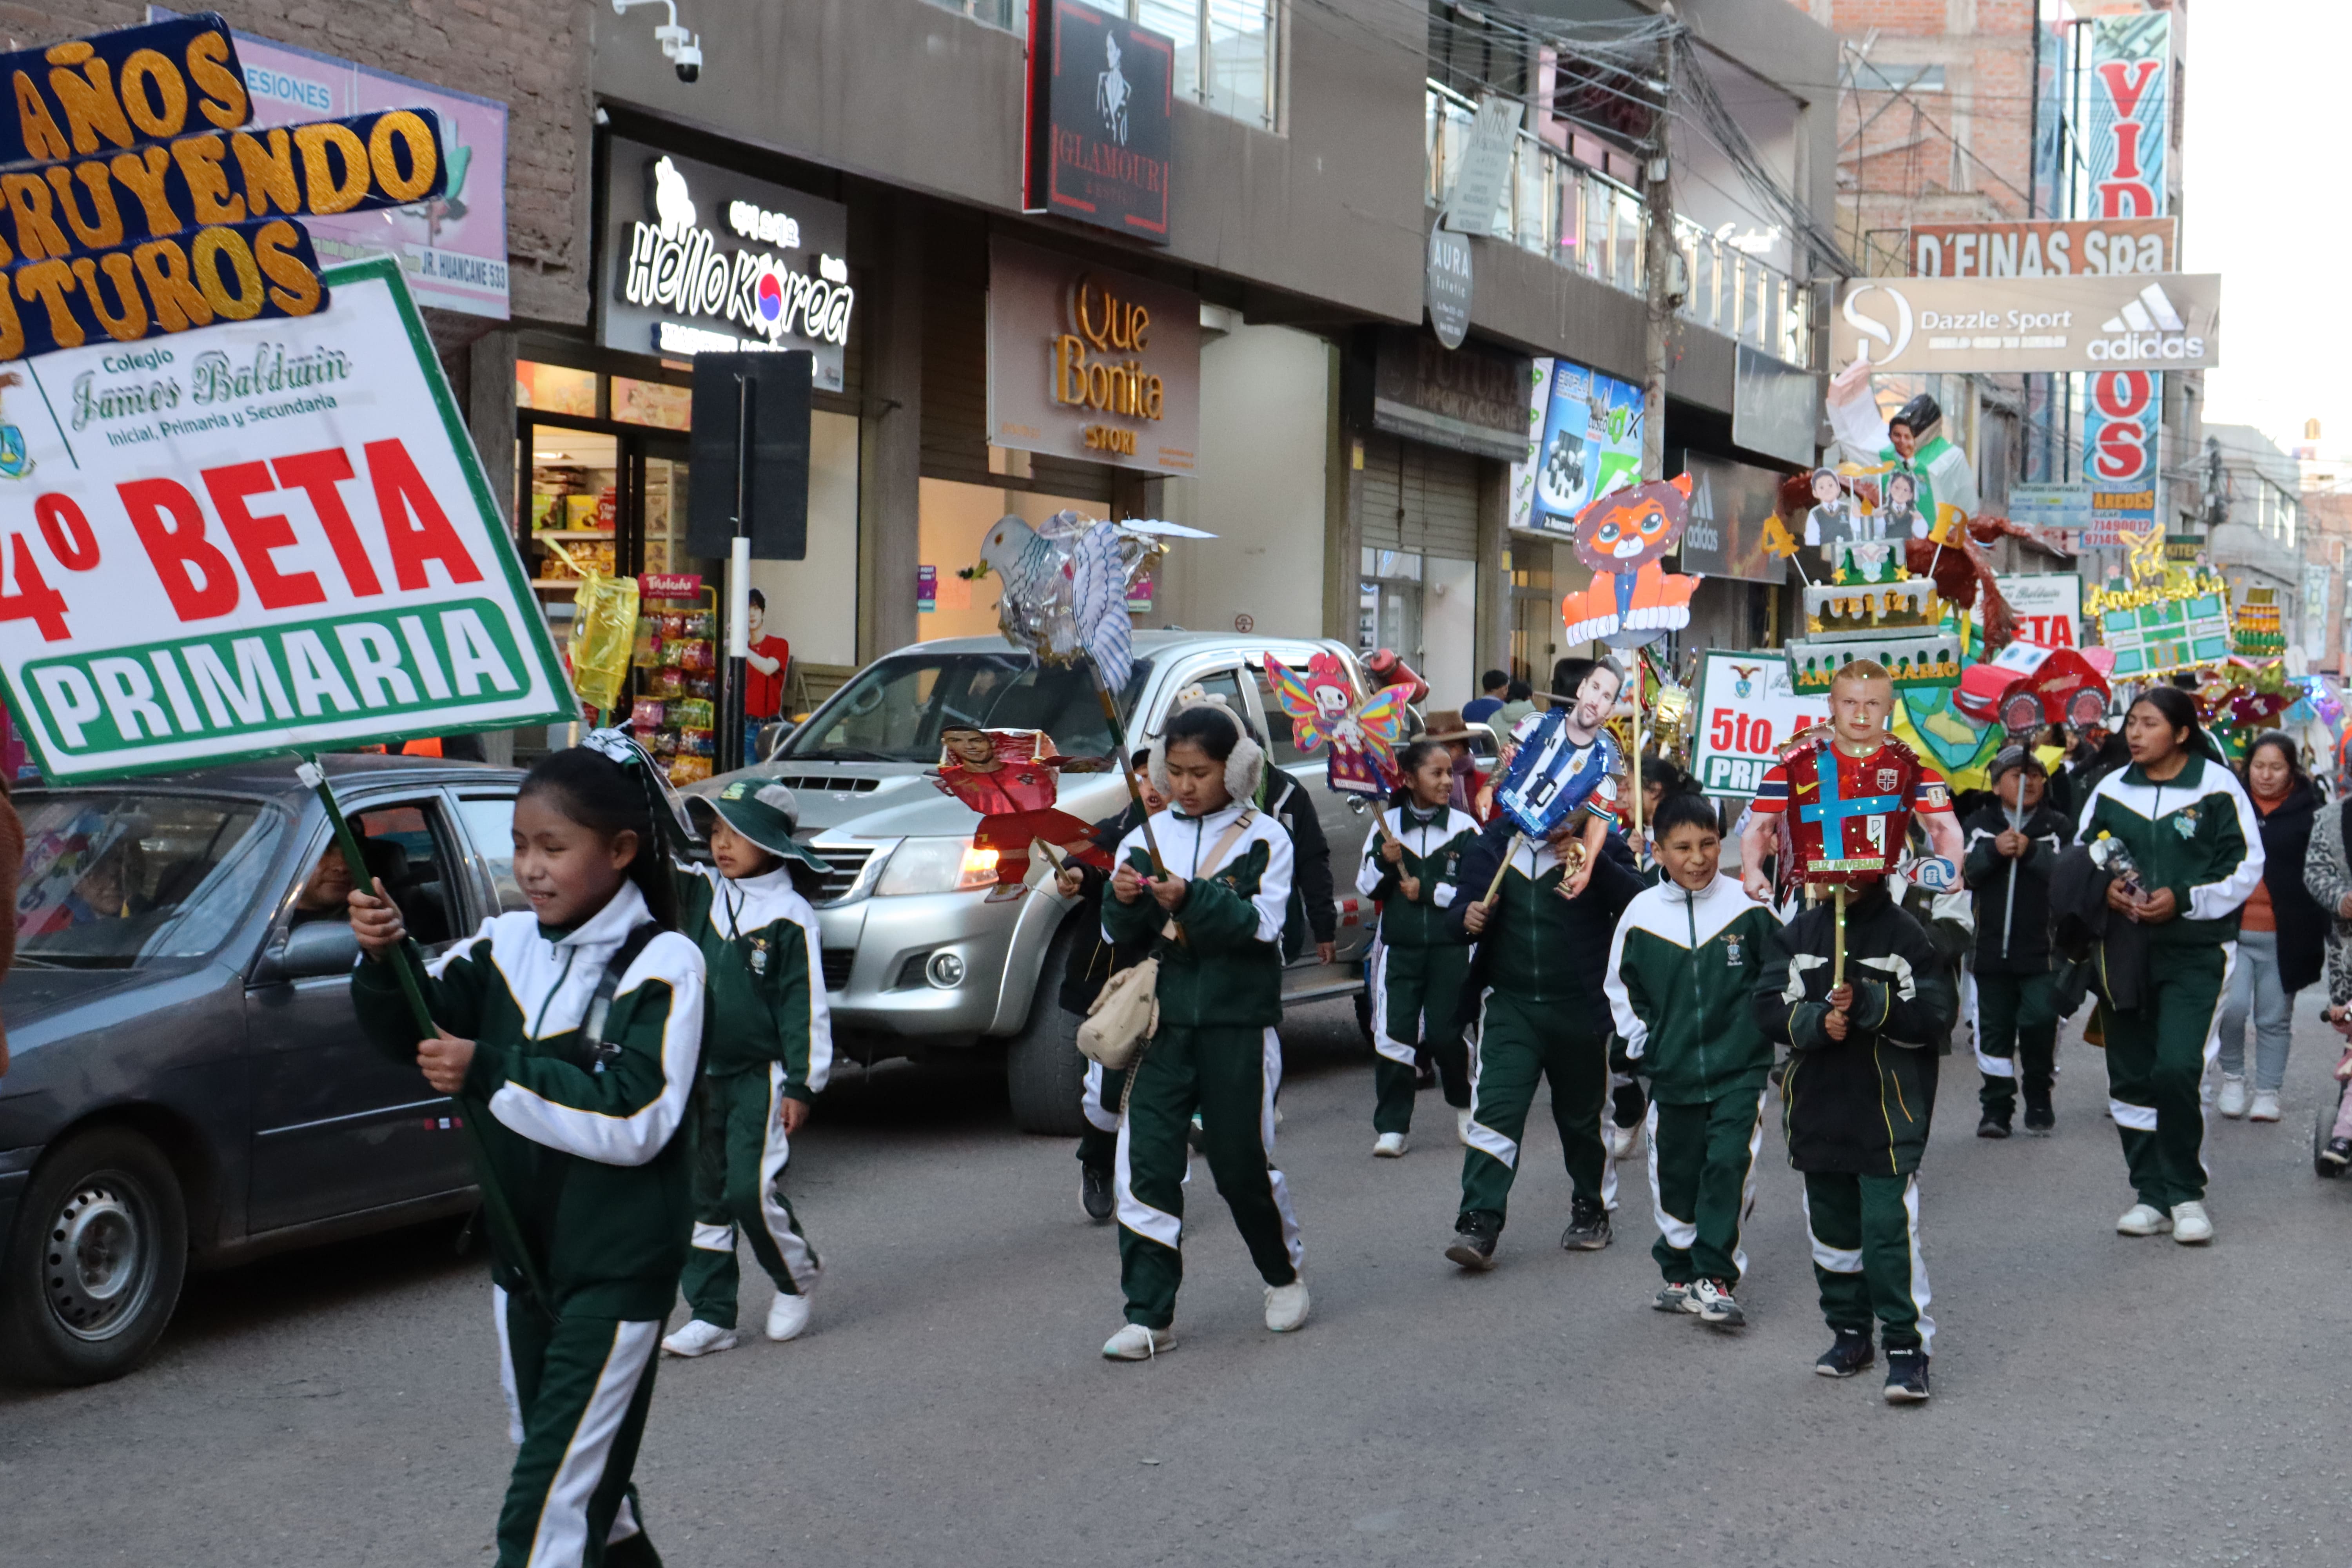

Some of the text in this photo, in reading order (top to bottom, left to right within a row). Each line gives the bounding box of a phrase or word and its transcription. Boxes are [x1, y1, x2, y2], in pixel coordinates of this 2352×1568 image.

[13, 31, 247, 162] AÑOS
[246, 68, 330, 109] ESIONES
[1059, 129, 1159, 192] GLAMOUR
[0, 111, 437, 267] RUYENDO
[422, 250, 437, 277] JR.
[439, 253, 487, 286] HUANCANE
[489, 264, 505, 289] 533
[627, 222, 728, 316] Hello
[1434, 240, 1469, 279] AURA
[2083, 230, 2163, 277] Spa
[1075, 271, 1149, 352] Que
[1921, 310, 2073, 334] Dazzle Sport
[102, 348, 174, 374] Colegio
[2087, 331, 2205, 361] adidas
[193, 342, 353, 406] Baldwin
[1056, 334, 1163, 420] Bonita
[159, 413, 229, 438] Primaria
[235, 414, 245, 428] y
[249, 394, 338, 423] Secundaria
[116, 437, 484, 622] BETA
[1687, 520, 1718, 552] adidas
[2093, 519, 2151, 532] 71490012
[646, 575, 691, 591] Trululu
[1833, 593, 1909, 613] FELIZ
[2011, 615, 2074, 646] ETA
[31, 608, 519, 748] PRIMARIA
[1711, 757, 1779, 789] PRI
[1866, 815, 1886, 855] 9
[1809, 860, 1829, 870] FELIZ
